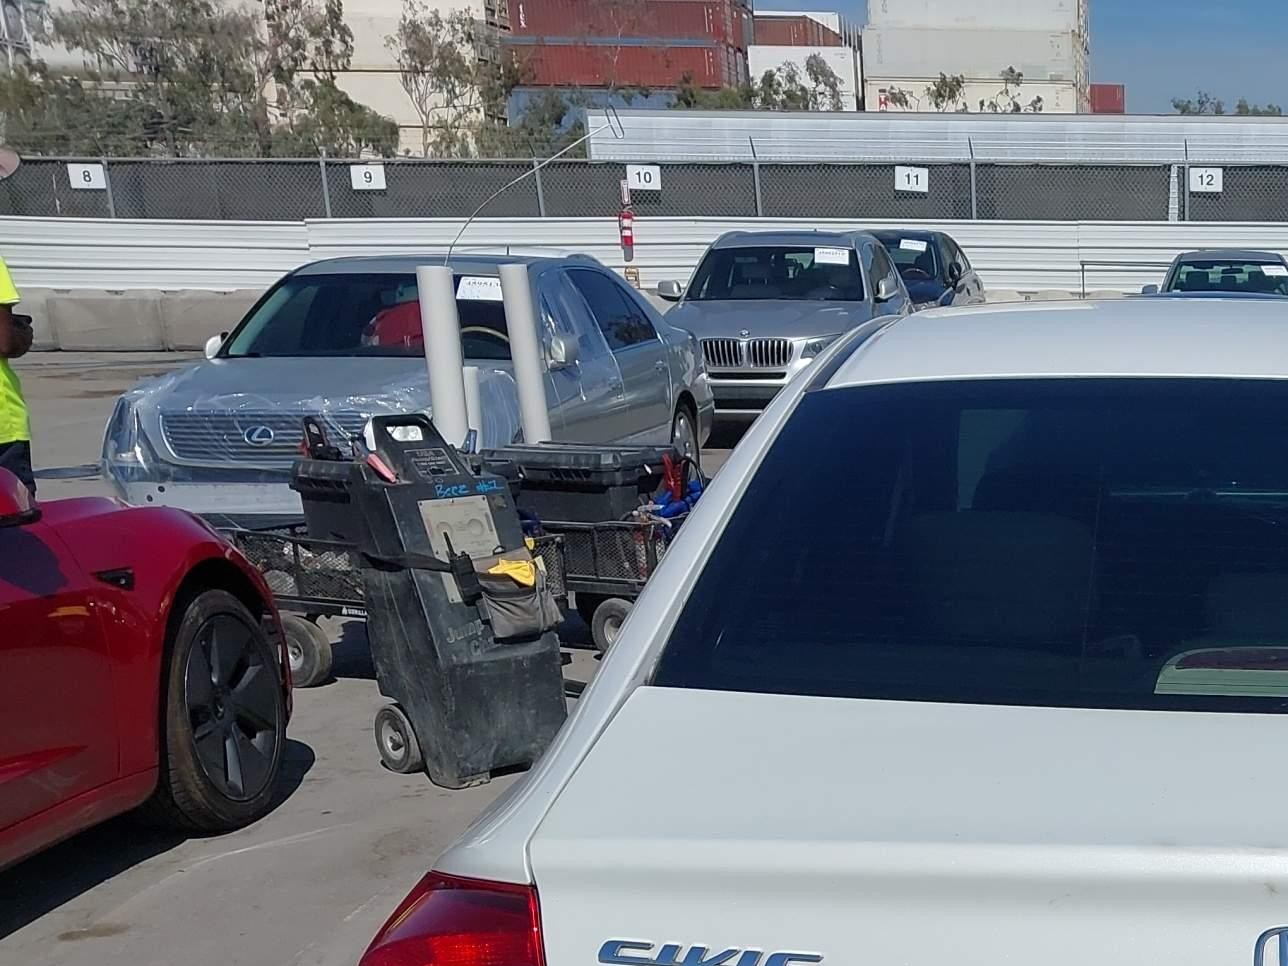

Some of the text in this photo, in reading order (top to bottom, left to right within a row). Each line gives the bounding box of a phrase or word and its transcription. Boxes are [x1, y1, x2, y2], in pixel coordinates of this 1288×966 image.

[82, 170, 92, 183] 8
[363, 171, 373, 184] 9
[635, 171, 652, 184] 10
[905, 172, 919, 185] 11
[1198, 173, 1214, 186] 12
